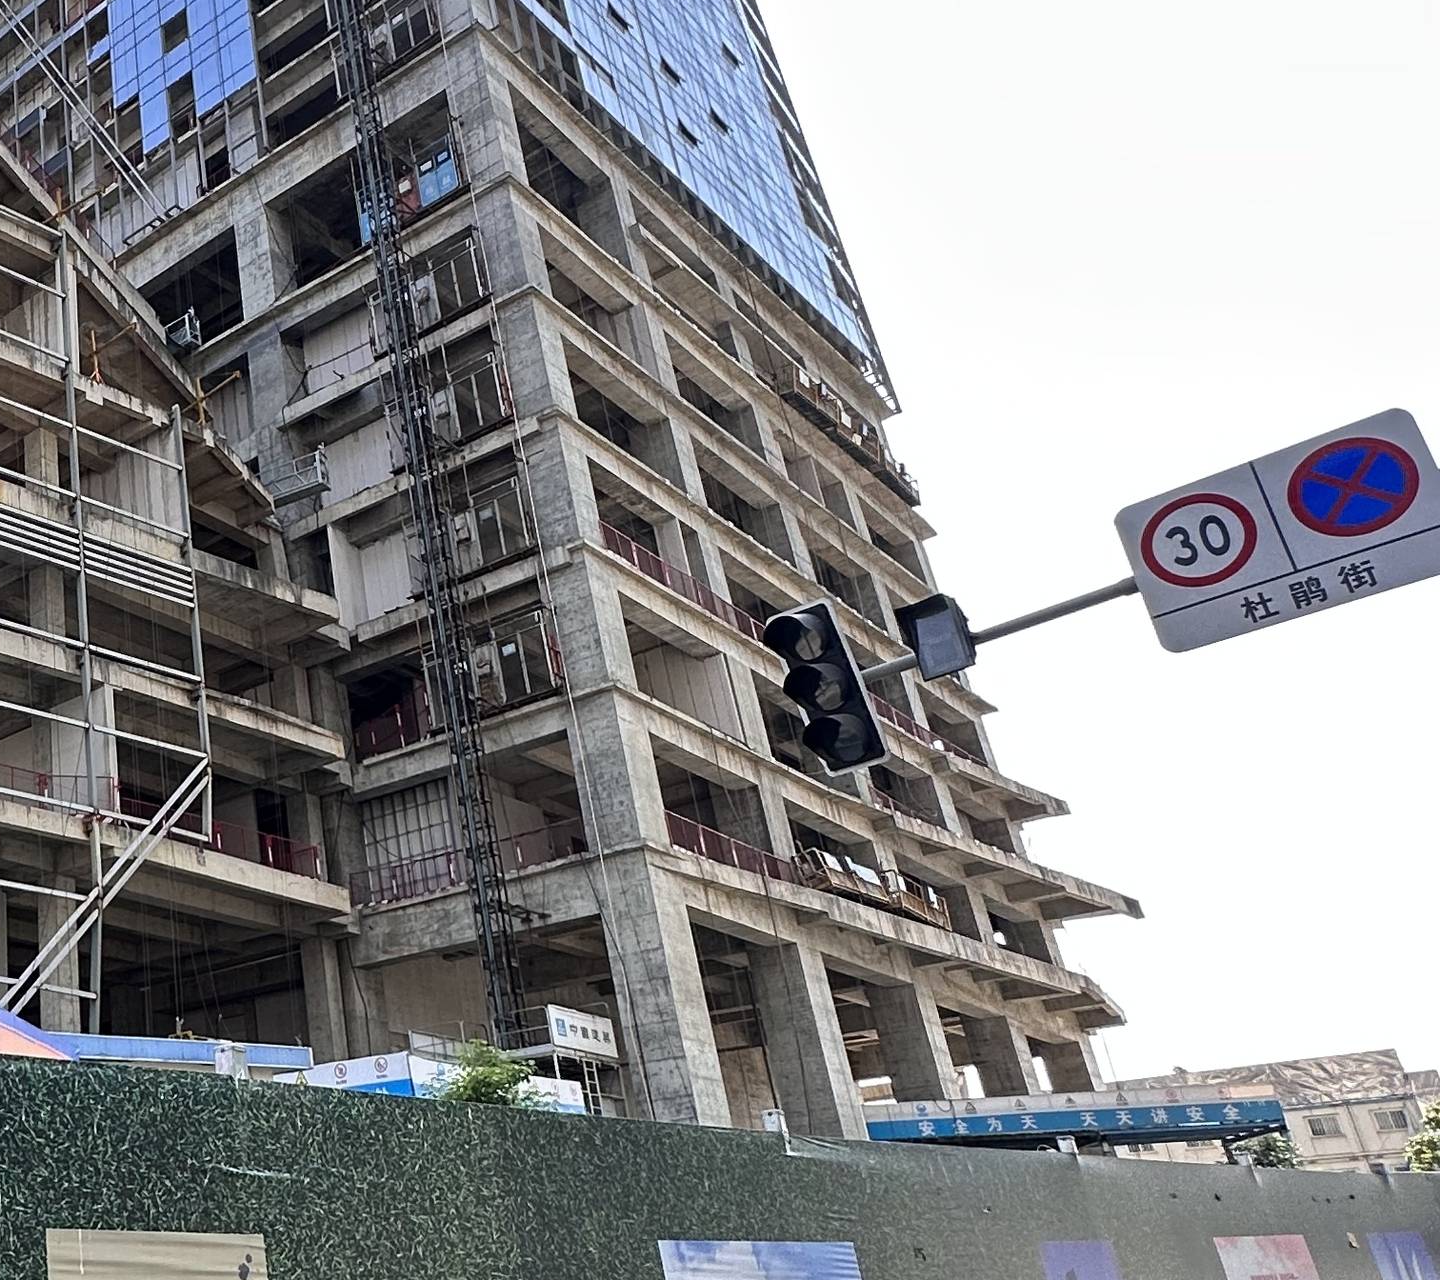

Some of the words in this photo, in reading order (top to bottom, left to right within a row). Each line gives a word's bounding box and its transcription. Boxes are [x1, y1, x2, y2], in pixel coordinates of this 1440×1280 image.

[1165, 514, 1231, 567] 30
[1240, 559, 1379, 624] 杜鹃街
[918, 1114, 1038, 1137] 安全为天
[1079, 1103, 1242, 1128] 天天讲安全
